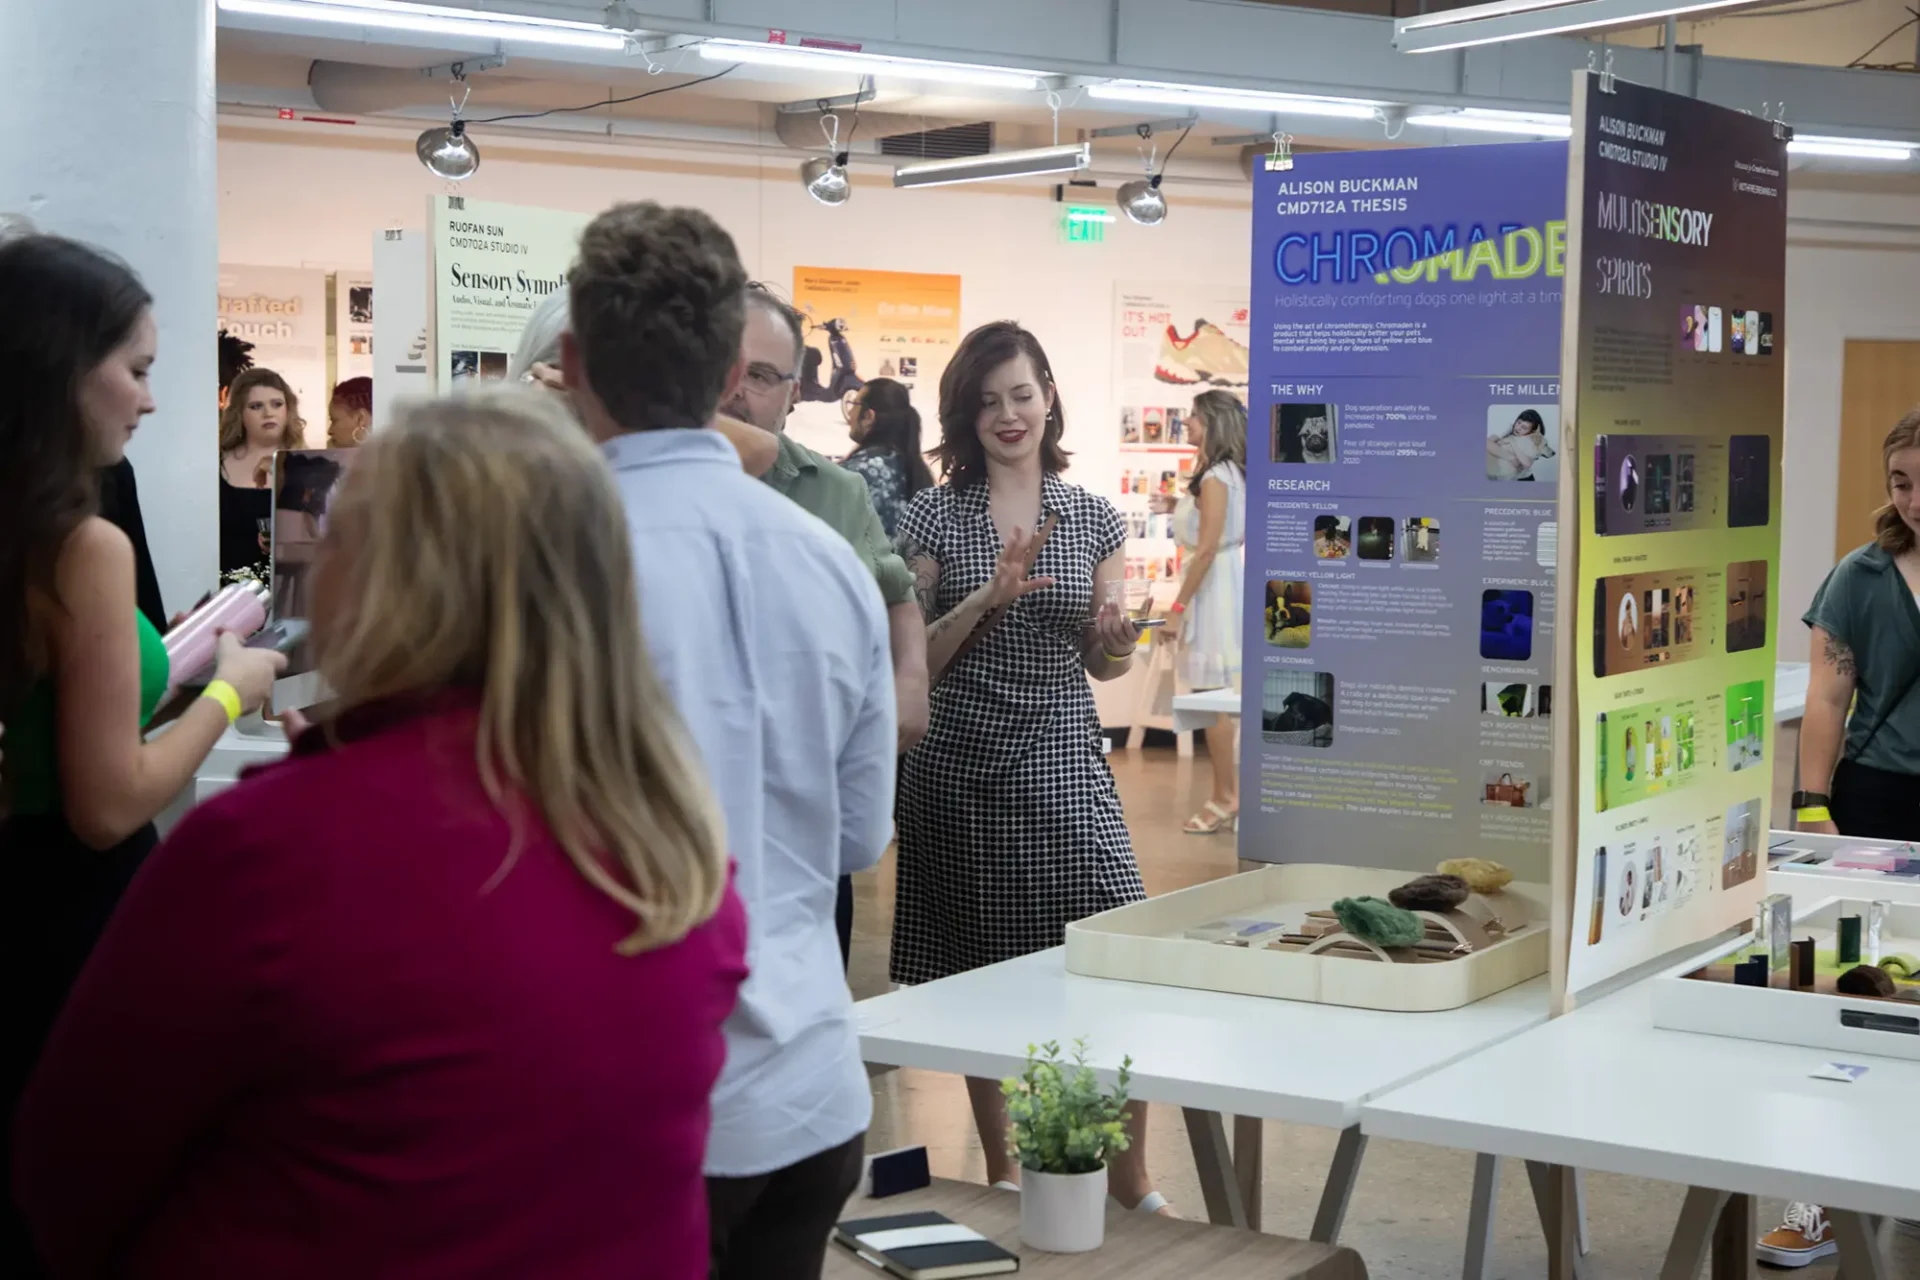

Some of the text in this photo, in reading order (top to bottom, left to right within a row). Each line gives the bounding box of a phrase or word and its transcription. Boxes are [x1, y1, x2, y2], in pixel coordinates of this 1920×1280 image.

[1599, 115, 1666, 147] ALISON BUCKMAN
[1632, 150, 1659, 171] STUDIO
[1659, 156, 1668, 172] IV
[1278, 177, 1418, 195] ALISON BUCKMAN
[1277, 198, 1407, 215] CMD712A THESIS
[449, 220, 504, 237] RUOFAN SUN
[1070, 207, 1106, 242] EXIT
[449, 237, 529, 255] CMD702A STUDIO IV
[451, 262, 512, 299] Sensory
[1596, 256, 1652, 299] SPIRITS
[1275, 293, 1338, 309] Holistically
[1341, 292, 1411, 309] comforting
[1415, 292, 1447, 308] dogs
[1450, 294, 1475, 305] one
[1479, 291, 1508, 307] light
[1511, 292, 1524, 304] at
[1527, 294, 1536, 303] a
[1148, 312, 1172, 324] HOT
[1123, 326, 1147, 338] OUT
[1338, 337, 1356, 345] using
[1305, 345, 1329, 353] anxiety
[1272, 384, 1324, 395] THE WHY
[1489, 384, 1514, 396] THE
[1345, 404, 1357, 412] Dog
[1268, 480, 1331, 491] RESEARCH
[1266, 569, 1356, 580] EXPERIMENT: YELLOW LIGHT
[1281, 656, 1315, 664] SCENARIO
[1496, 760, 1524, 768] TRENDS
